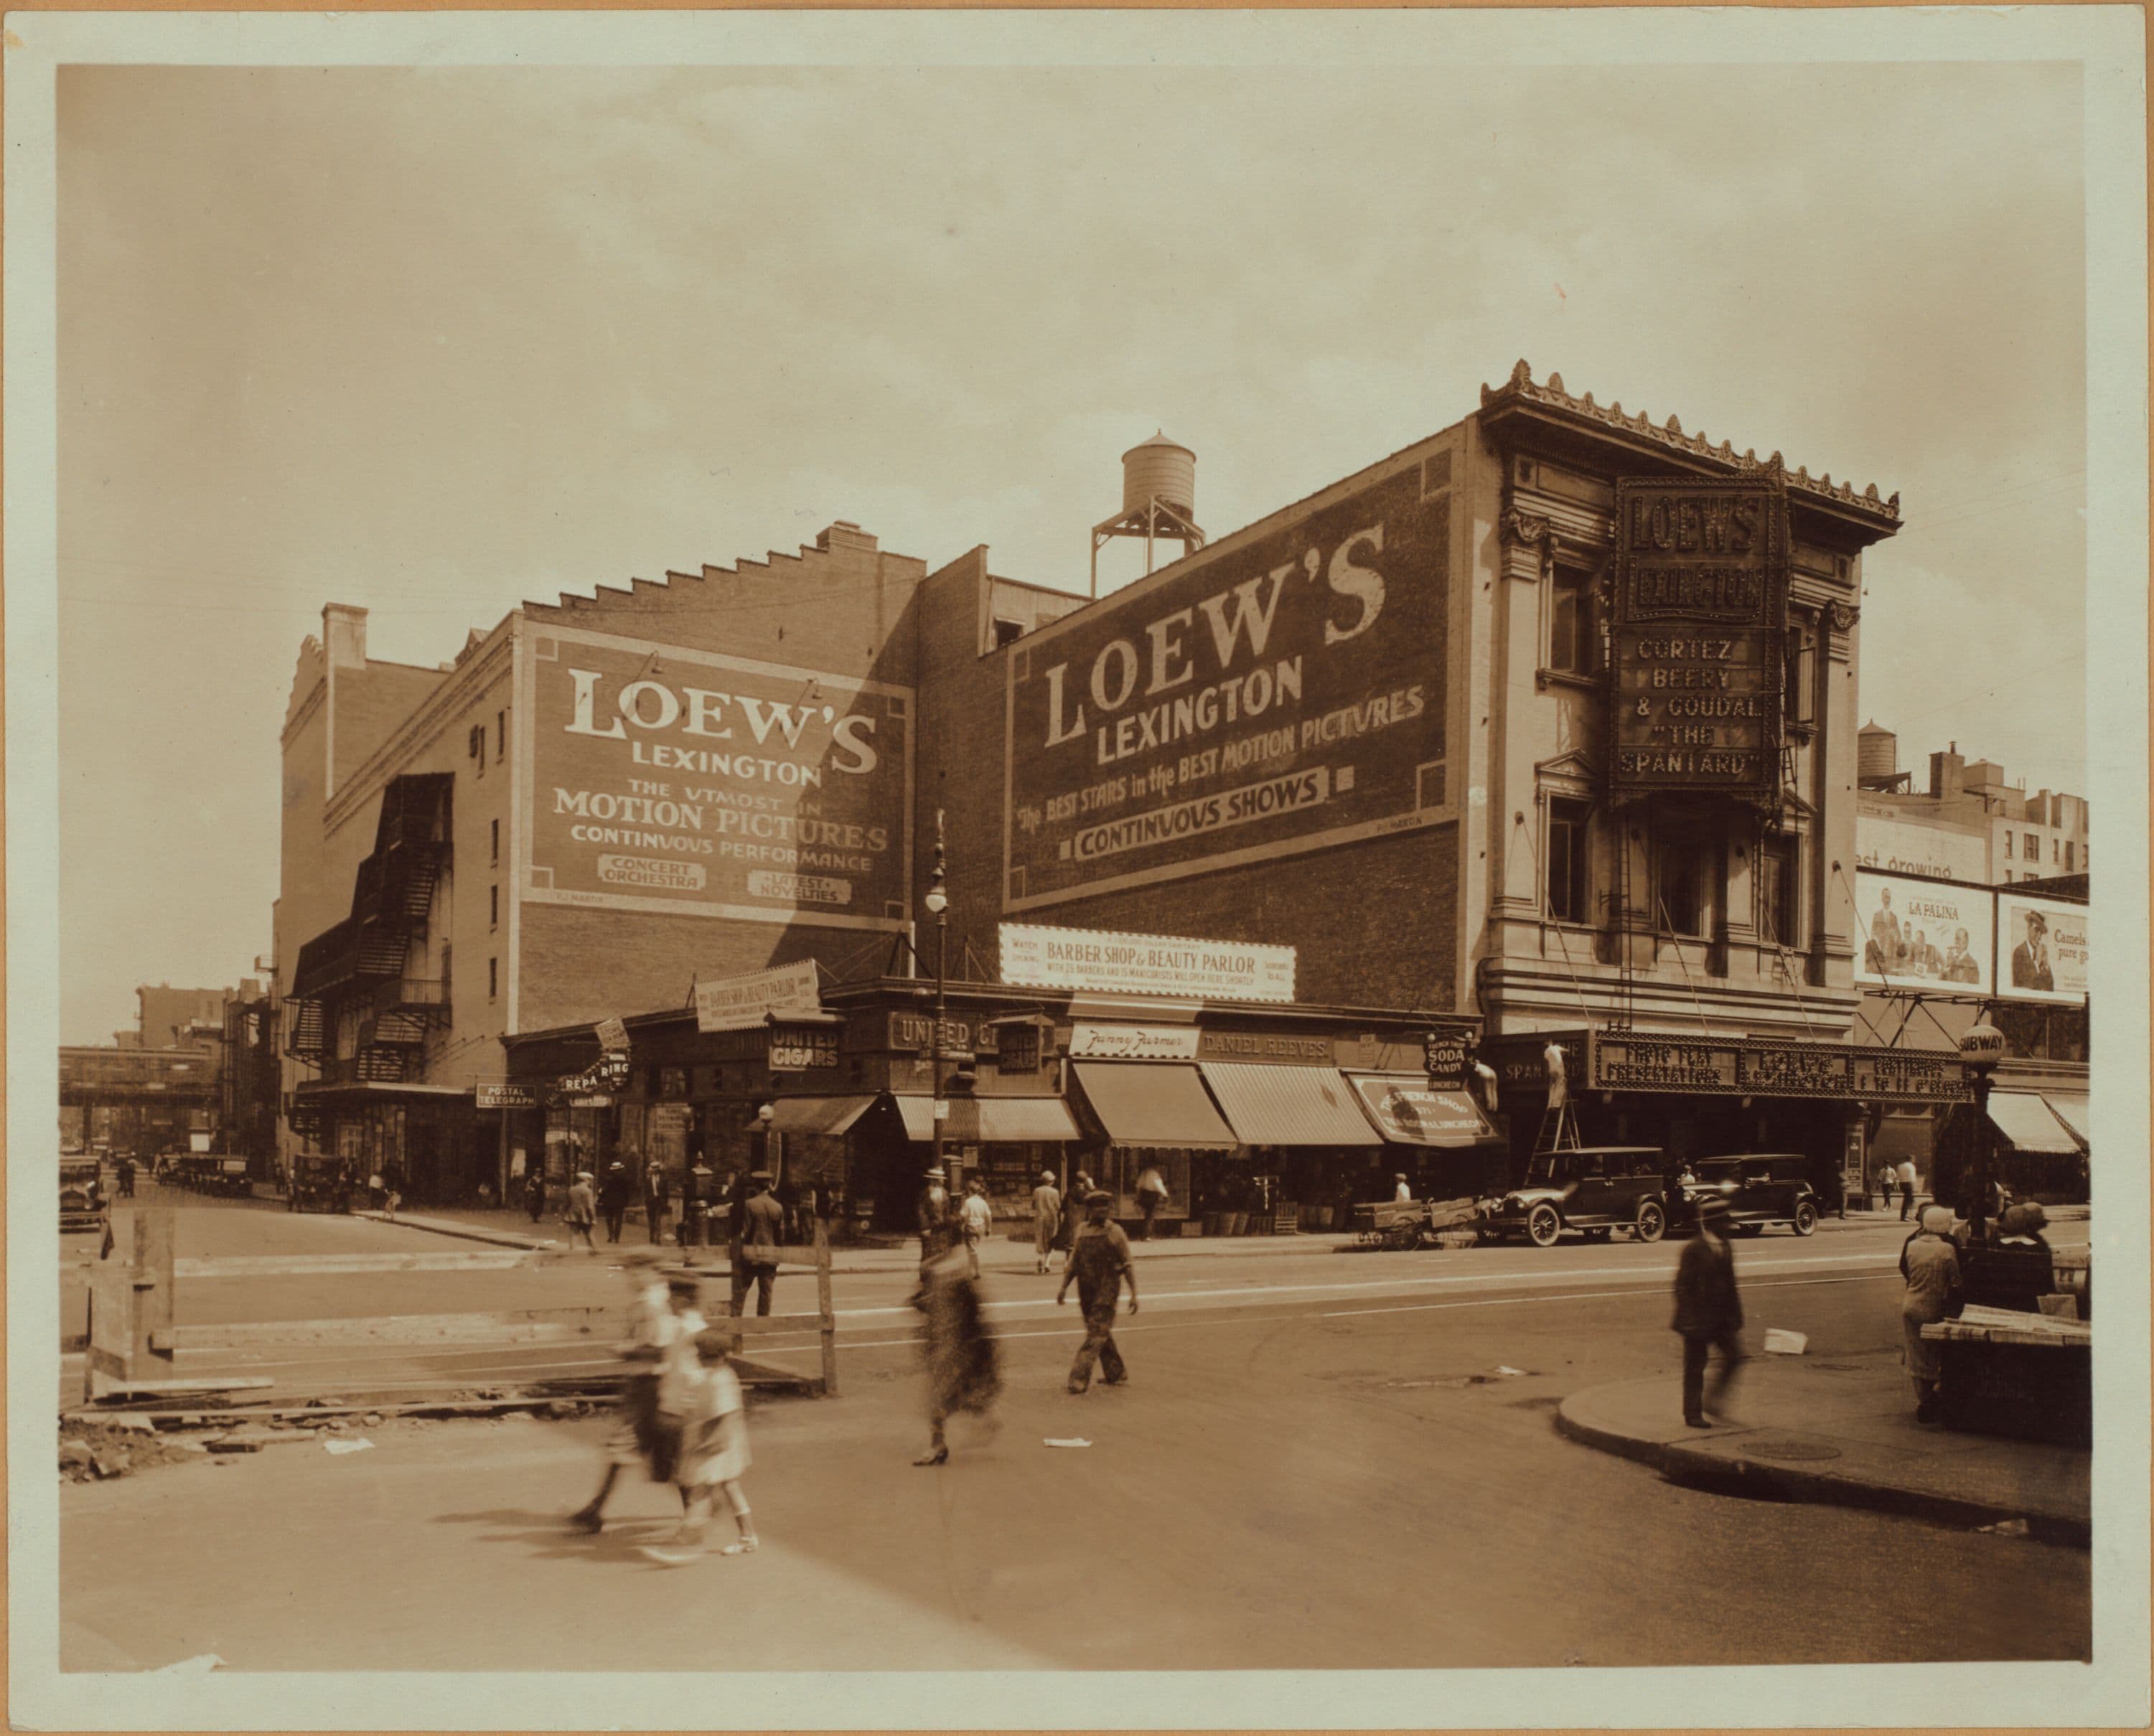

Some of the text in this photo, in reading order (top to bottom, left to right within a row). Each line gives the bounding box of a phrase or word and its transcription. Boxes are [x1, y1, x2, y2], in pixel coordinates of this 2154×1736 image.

[1044, 522, 1386, 748] LOEW'S
[1638, 639, 1732, 660] CORTEZ
[1652, 668, 1729, 689] BEERY
[1097, 655, 1302, 765] LEXINGTON
[1636, 697, 1650, 715] &
[564, 668, 877, 774] LOEW'S
[632, 741, 822, 788] LEXINGTON
[1046, 792, 1077, 821] BEST
[1080, 776, 1128, 811] STARS
[1131, 772, 1146, 797] in
[1179, 749, 1218, 784] BEST
[1221, 725, 1294, 771] MOTION
[628, 779, 670, 797] THE
[797, 802, 822, 817] IN
[1226, 771, 1318, 820] SHOWS
[553, 787, 888, 851] MOTION PICTURES
[720, 841, 874, 871] PERFORMANCE
[612, 858, 690, 875] CONCERT
[604, 869, 698, 888] ORCHESTRA
[760, 884, 838, 902] NOVELTIES
[1909, 901, 1959, 920] LA PALINA
[2054, 929, 2086, 946] Camels
[1047, 942, 1101, 962] BARBER
[1105, 947, 1135, 965] SHOP
[1137, 953, 1146, 966] &
[1148, 949, 1197, 970] BEAUTY
[1202, 954, 1255, 974] PARLOR
[2059, 947, 2077, 961] pure
[1047, 962, 1064, 972] WITH
[1077, 965, 1104, 975] BARBERS
[1107, 967, 1119, 977] AND
[773, 1029, 838, 1048] UNITED
[902, 1018, 970, 1043] UNIED
[1090, 1029, 1183, 1052] Fanny Farmer
[1204, 1036, 1260, 1054] DANIEL
[1960, 1034, 2003, 1053] SUBWAY
[772, 1048, 838, 1066] CIGARS
[1428, 1049, 1465, 1062] SODA
[1430, 1061, 1461, 1073] CANDY
[479, 1096, 534, 1105] TELEGRAPH
[488, 1087, 525, 1097] POSTAL
[1437, 1096, 1469, 1113] SHOP
